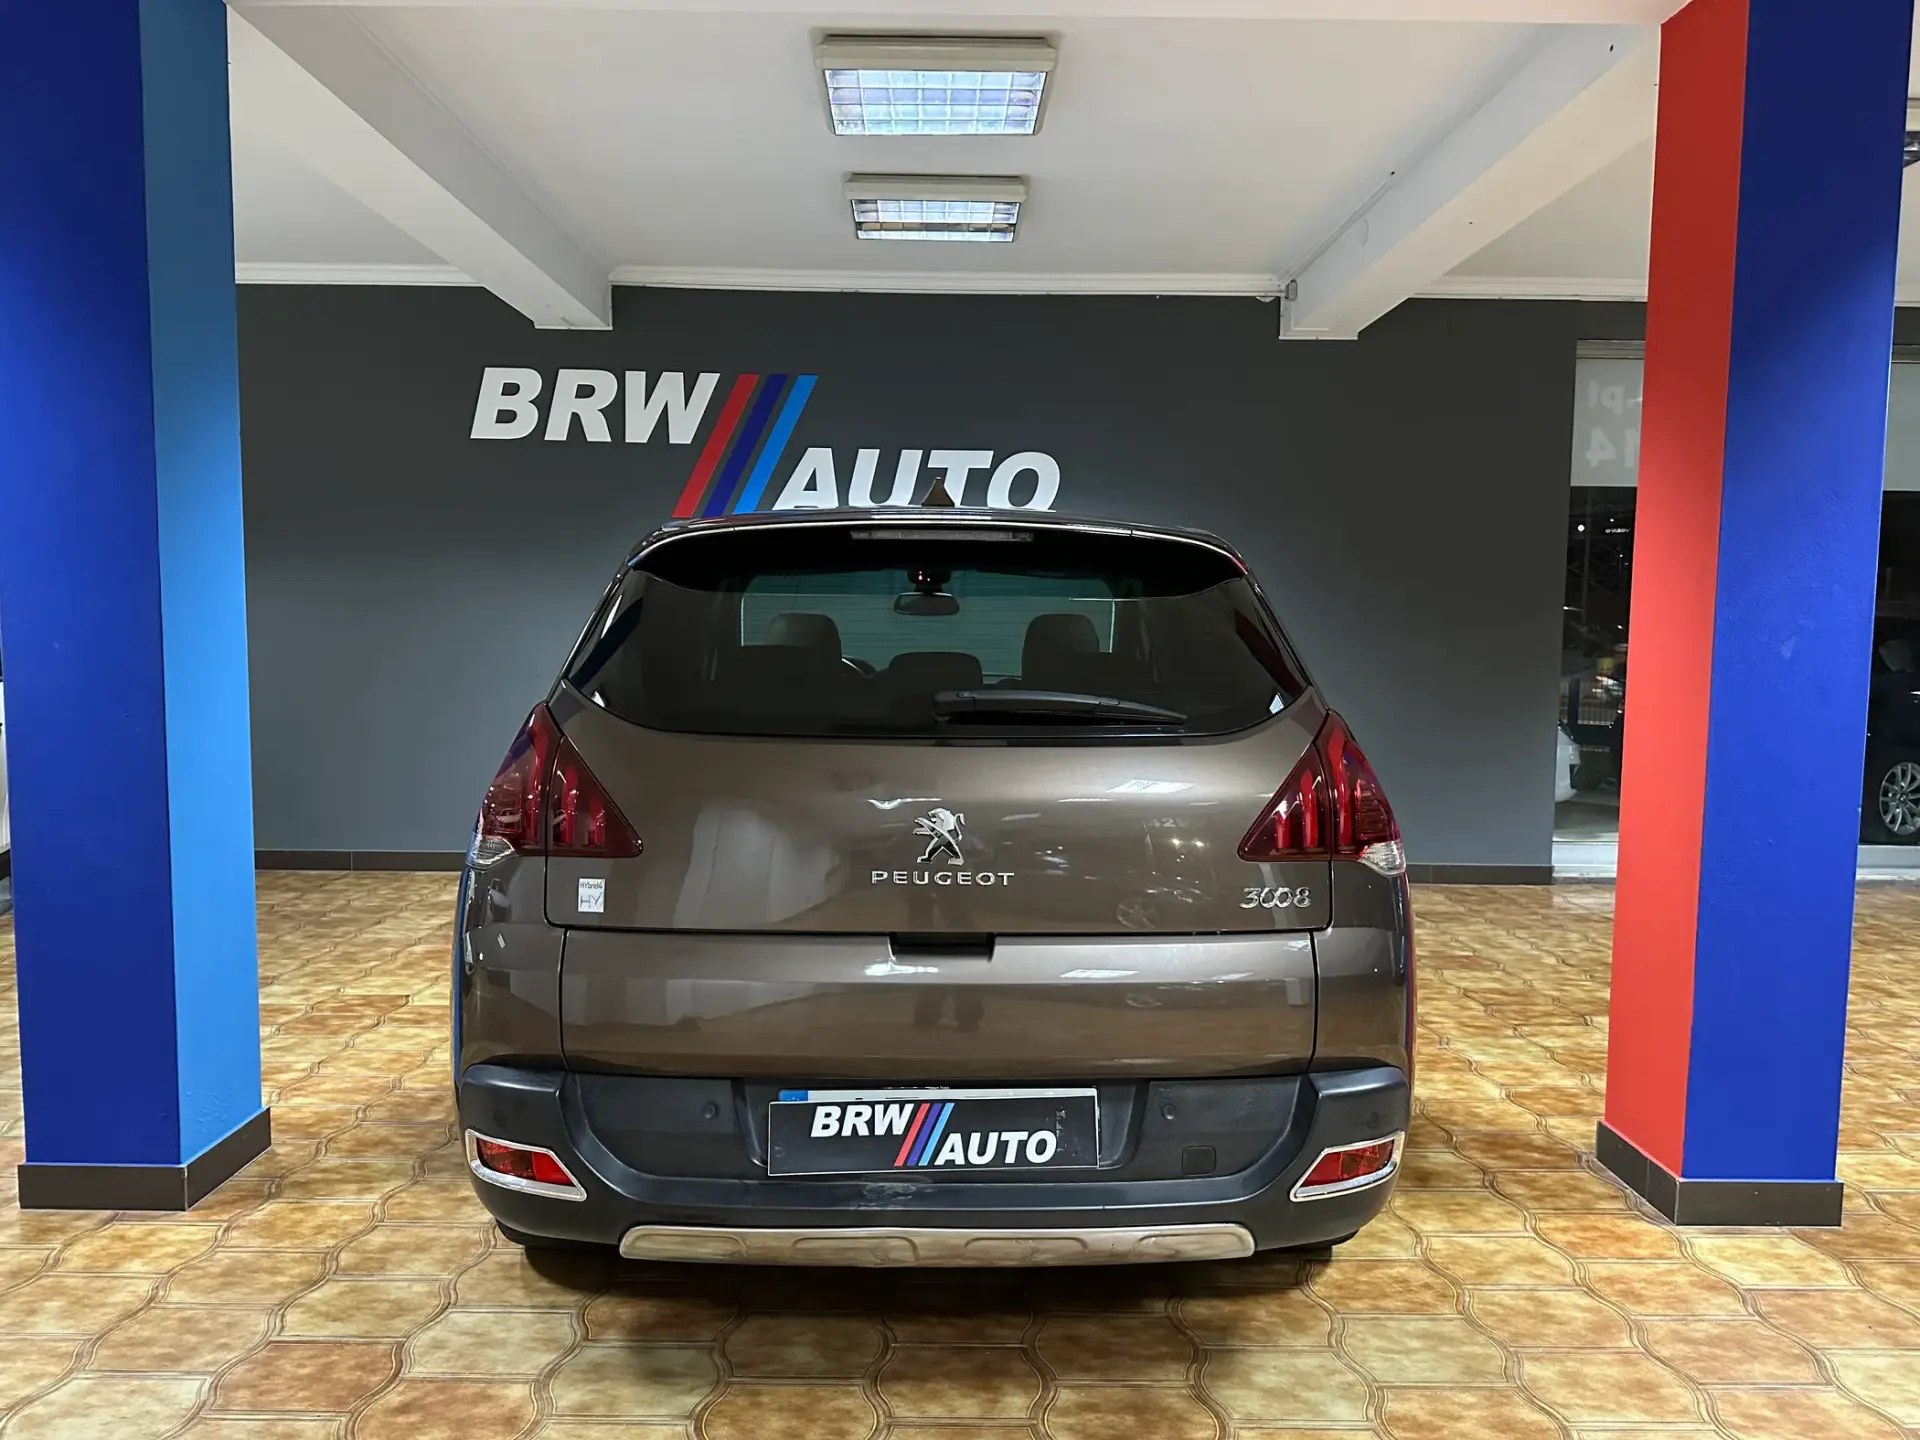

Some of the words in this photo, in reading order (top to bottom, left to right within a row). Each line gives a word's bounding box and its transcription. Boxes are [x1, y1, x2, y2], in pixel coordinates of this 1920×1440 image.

[470, 367, 721, 444] BRW
[772, 448, 1062, 512] AUTO
[871, 870, 1015, 887] PEUGEOT
[1239, 886, 1311, 908] 3008
[810, 1103, 914, 1138] BRW
[934, 1130, 1057, 1166] AUTO
